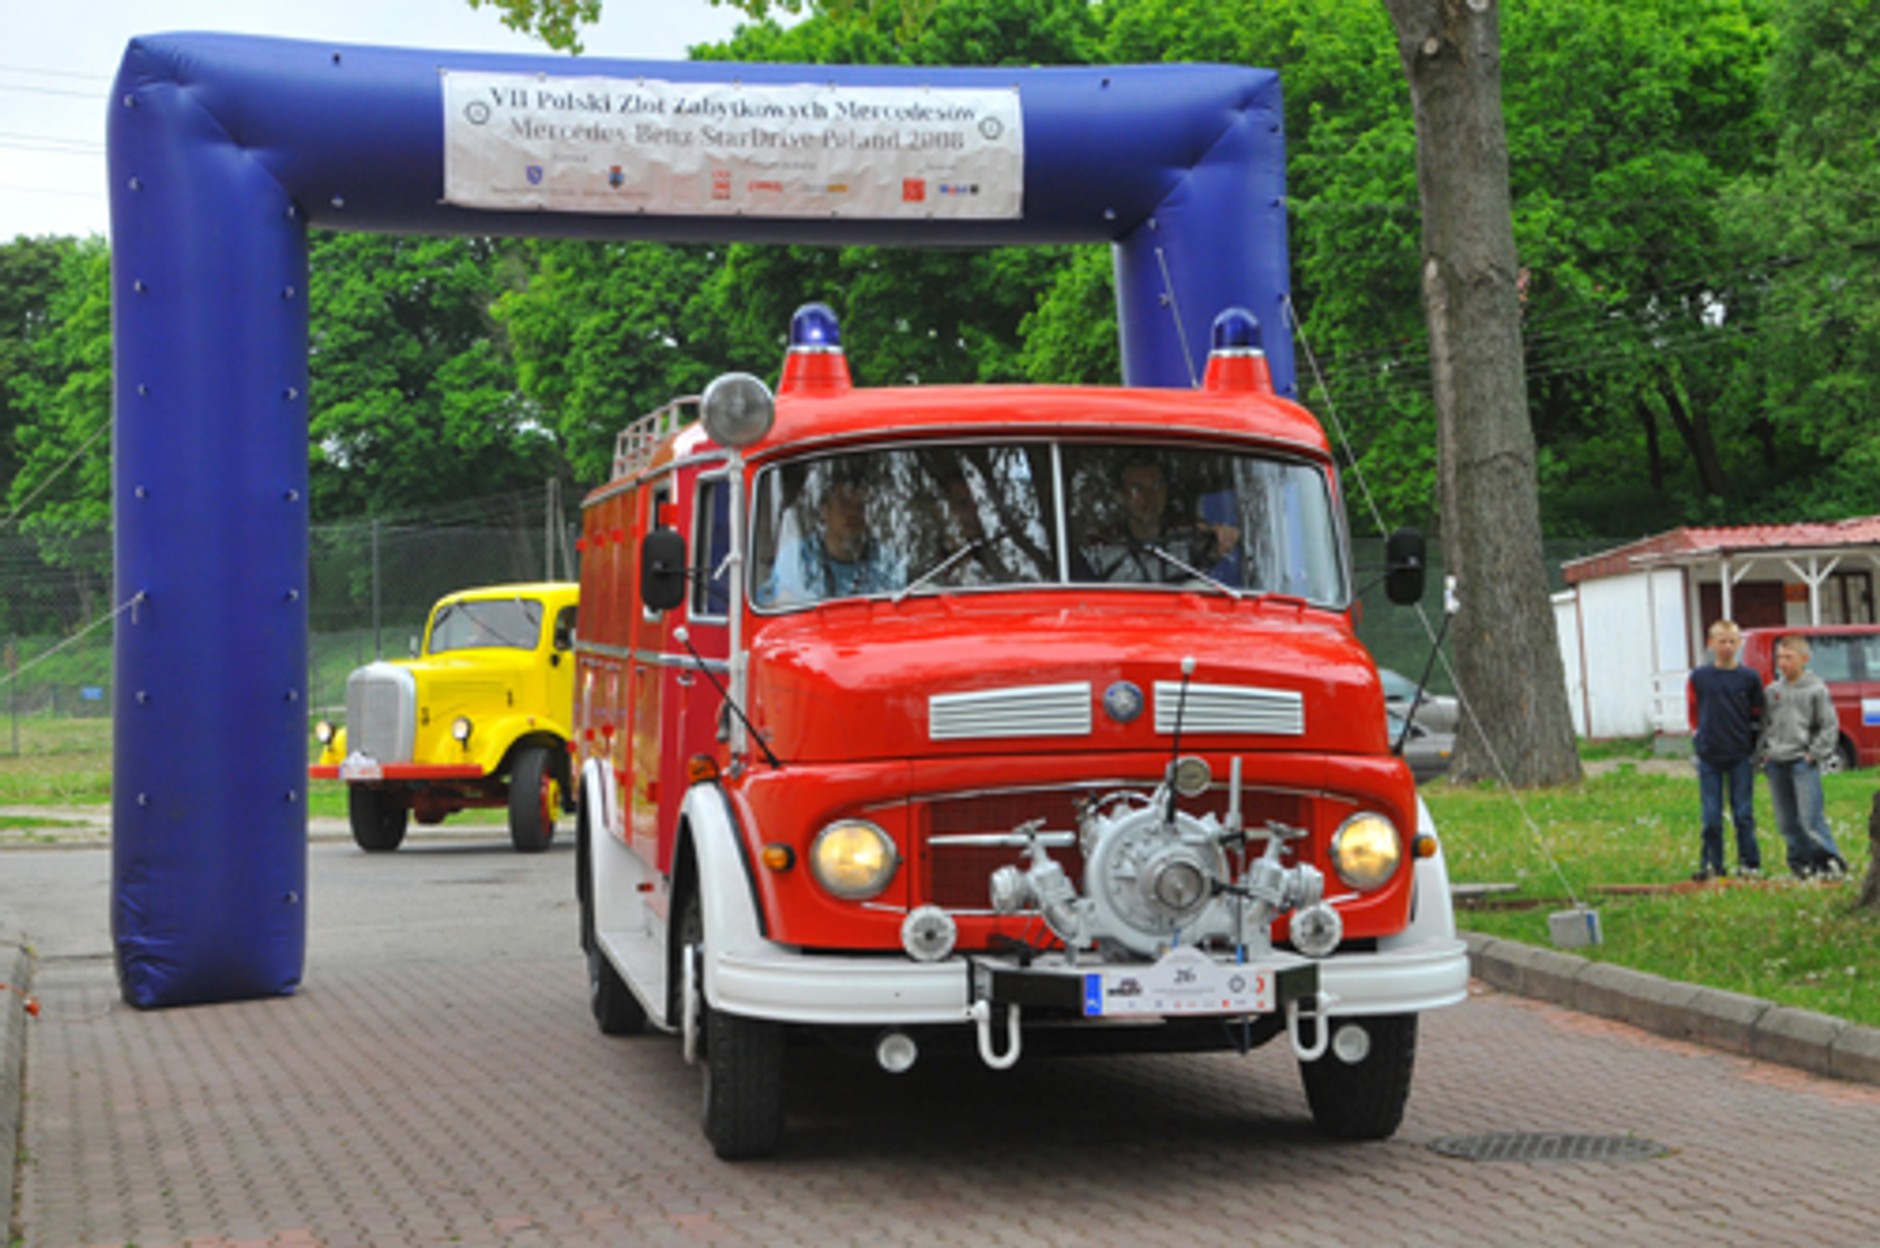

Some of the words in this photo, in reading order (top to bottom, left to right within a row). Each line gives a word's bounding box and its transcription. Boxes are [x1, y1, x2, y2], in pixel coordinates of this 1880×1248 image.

[538, 90, 611, 113] Polski
[511, 117, 626, 142] Mercedes
[636, 123, 692, 147] Benz
[700, 126, 817, 149] StarDrive
[823, 129, 899, 149] Poland
[909, 130, 966, 150] 2008
